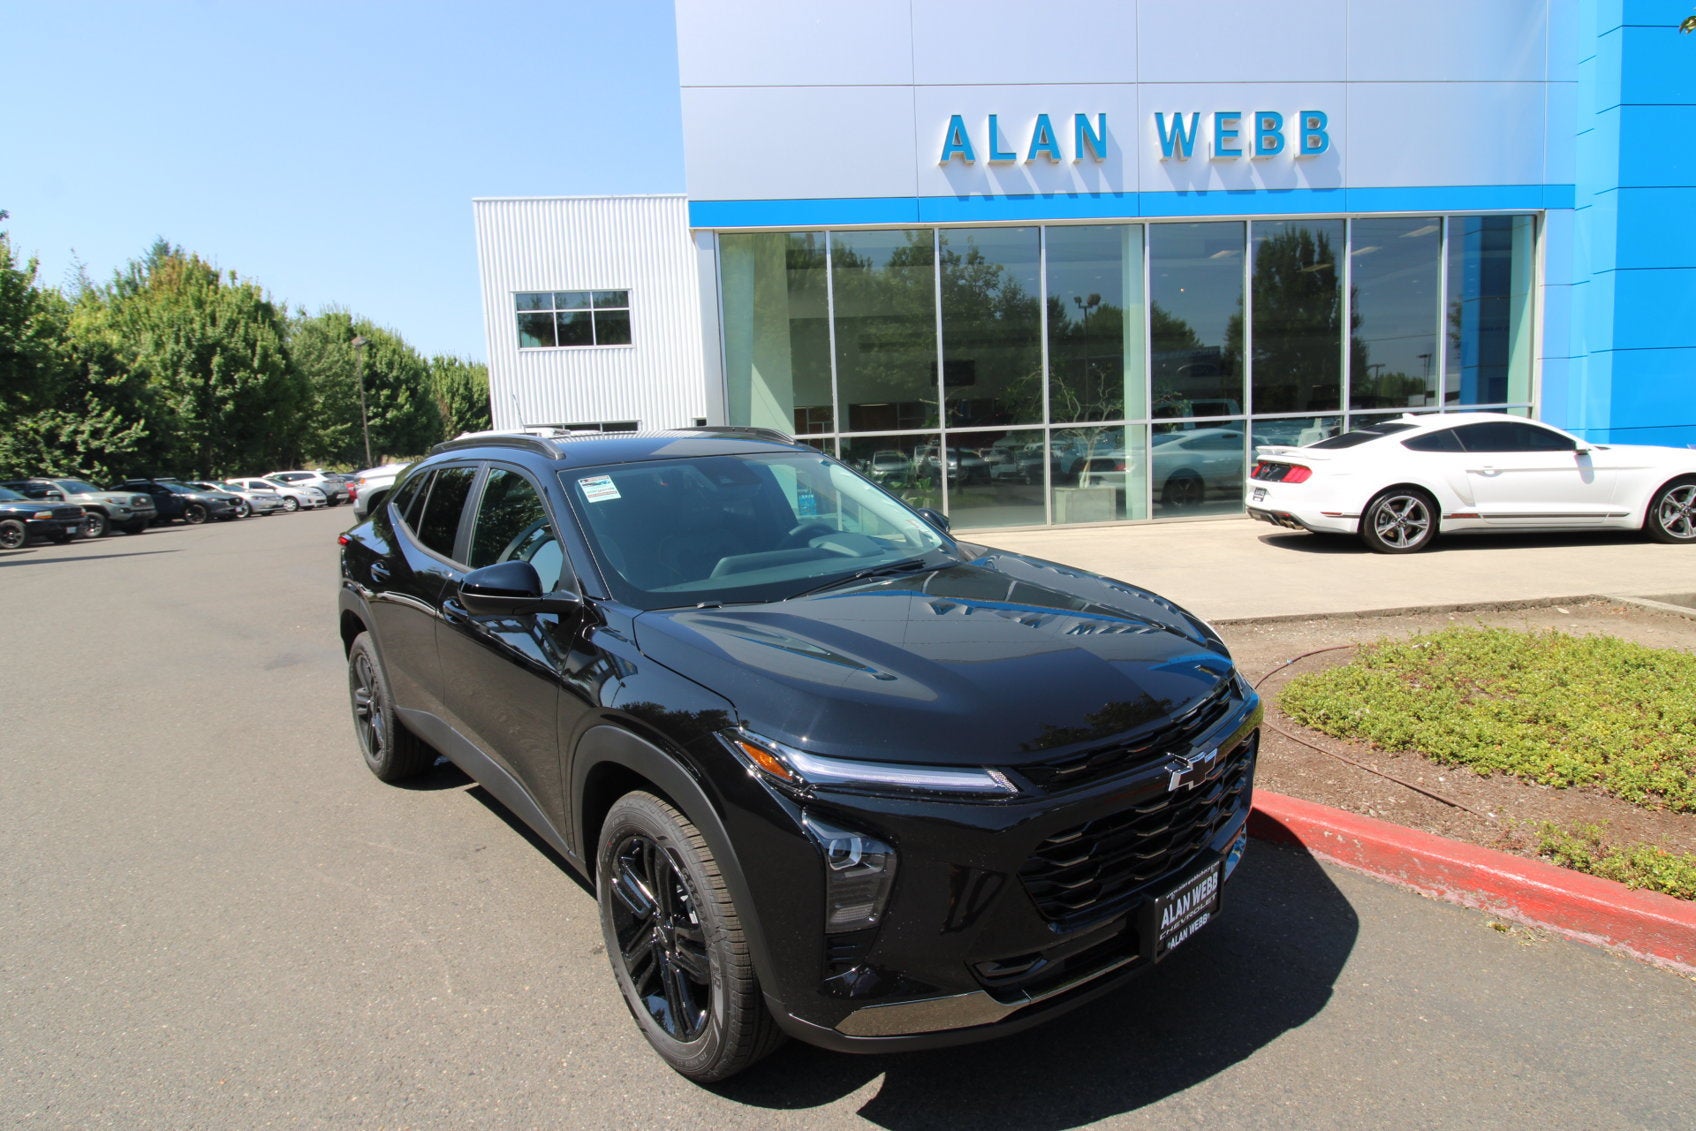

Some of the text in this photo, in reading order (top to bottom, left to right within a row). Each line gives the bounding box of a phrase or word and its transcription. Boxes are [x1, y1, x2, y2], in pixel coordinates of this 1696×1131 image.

[939, 110, 1330, 164] ALAN WEBB
[1159, 892, 1218, 941] CHEVROLET
[1160, 892, 1191, 930] ALAN
[1192, 871, 1219, 907] WEBB
[1170, 913, 1208, 950] ALAN WEBB
